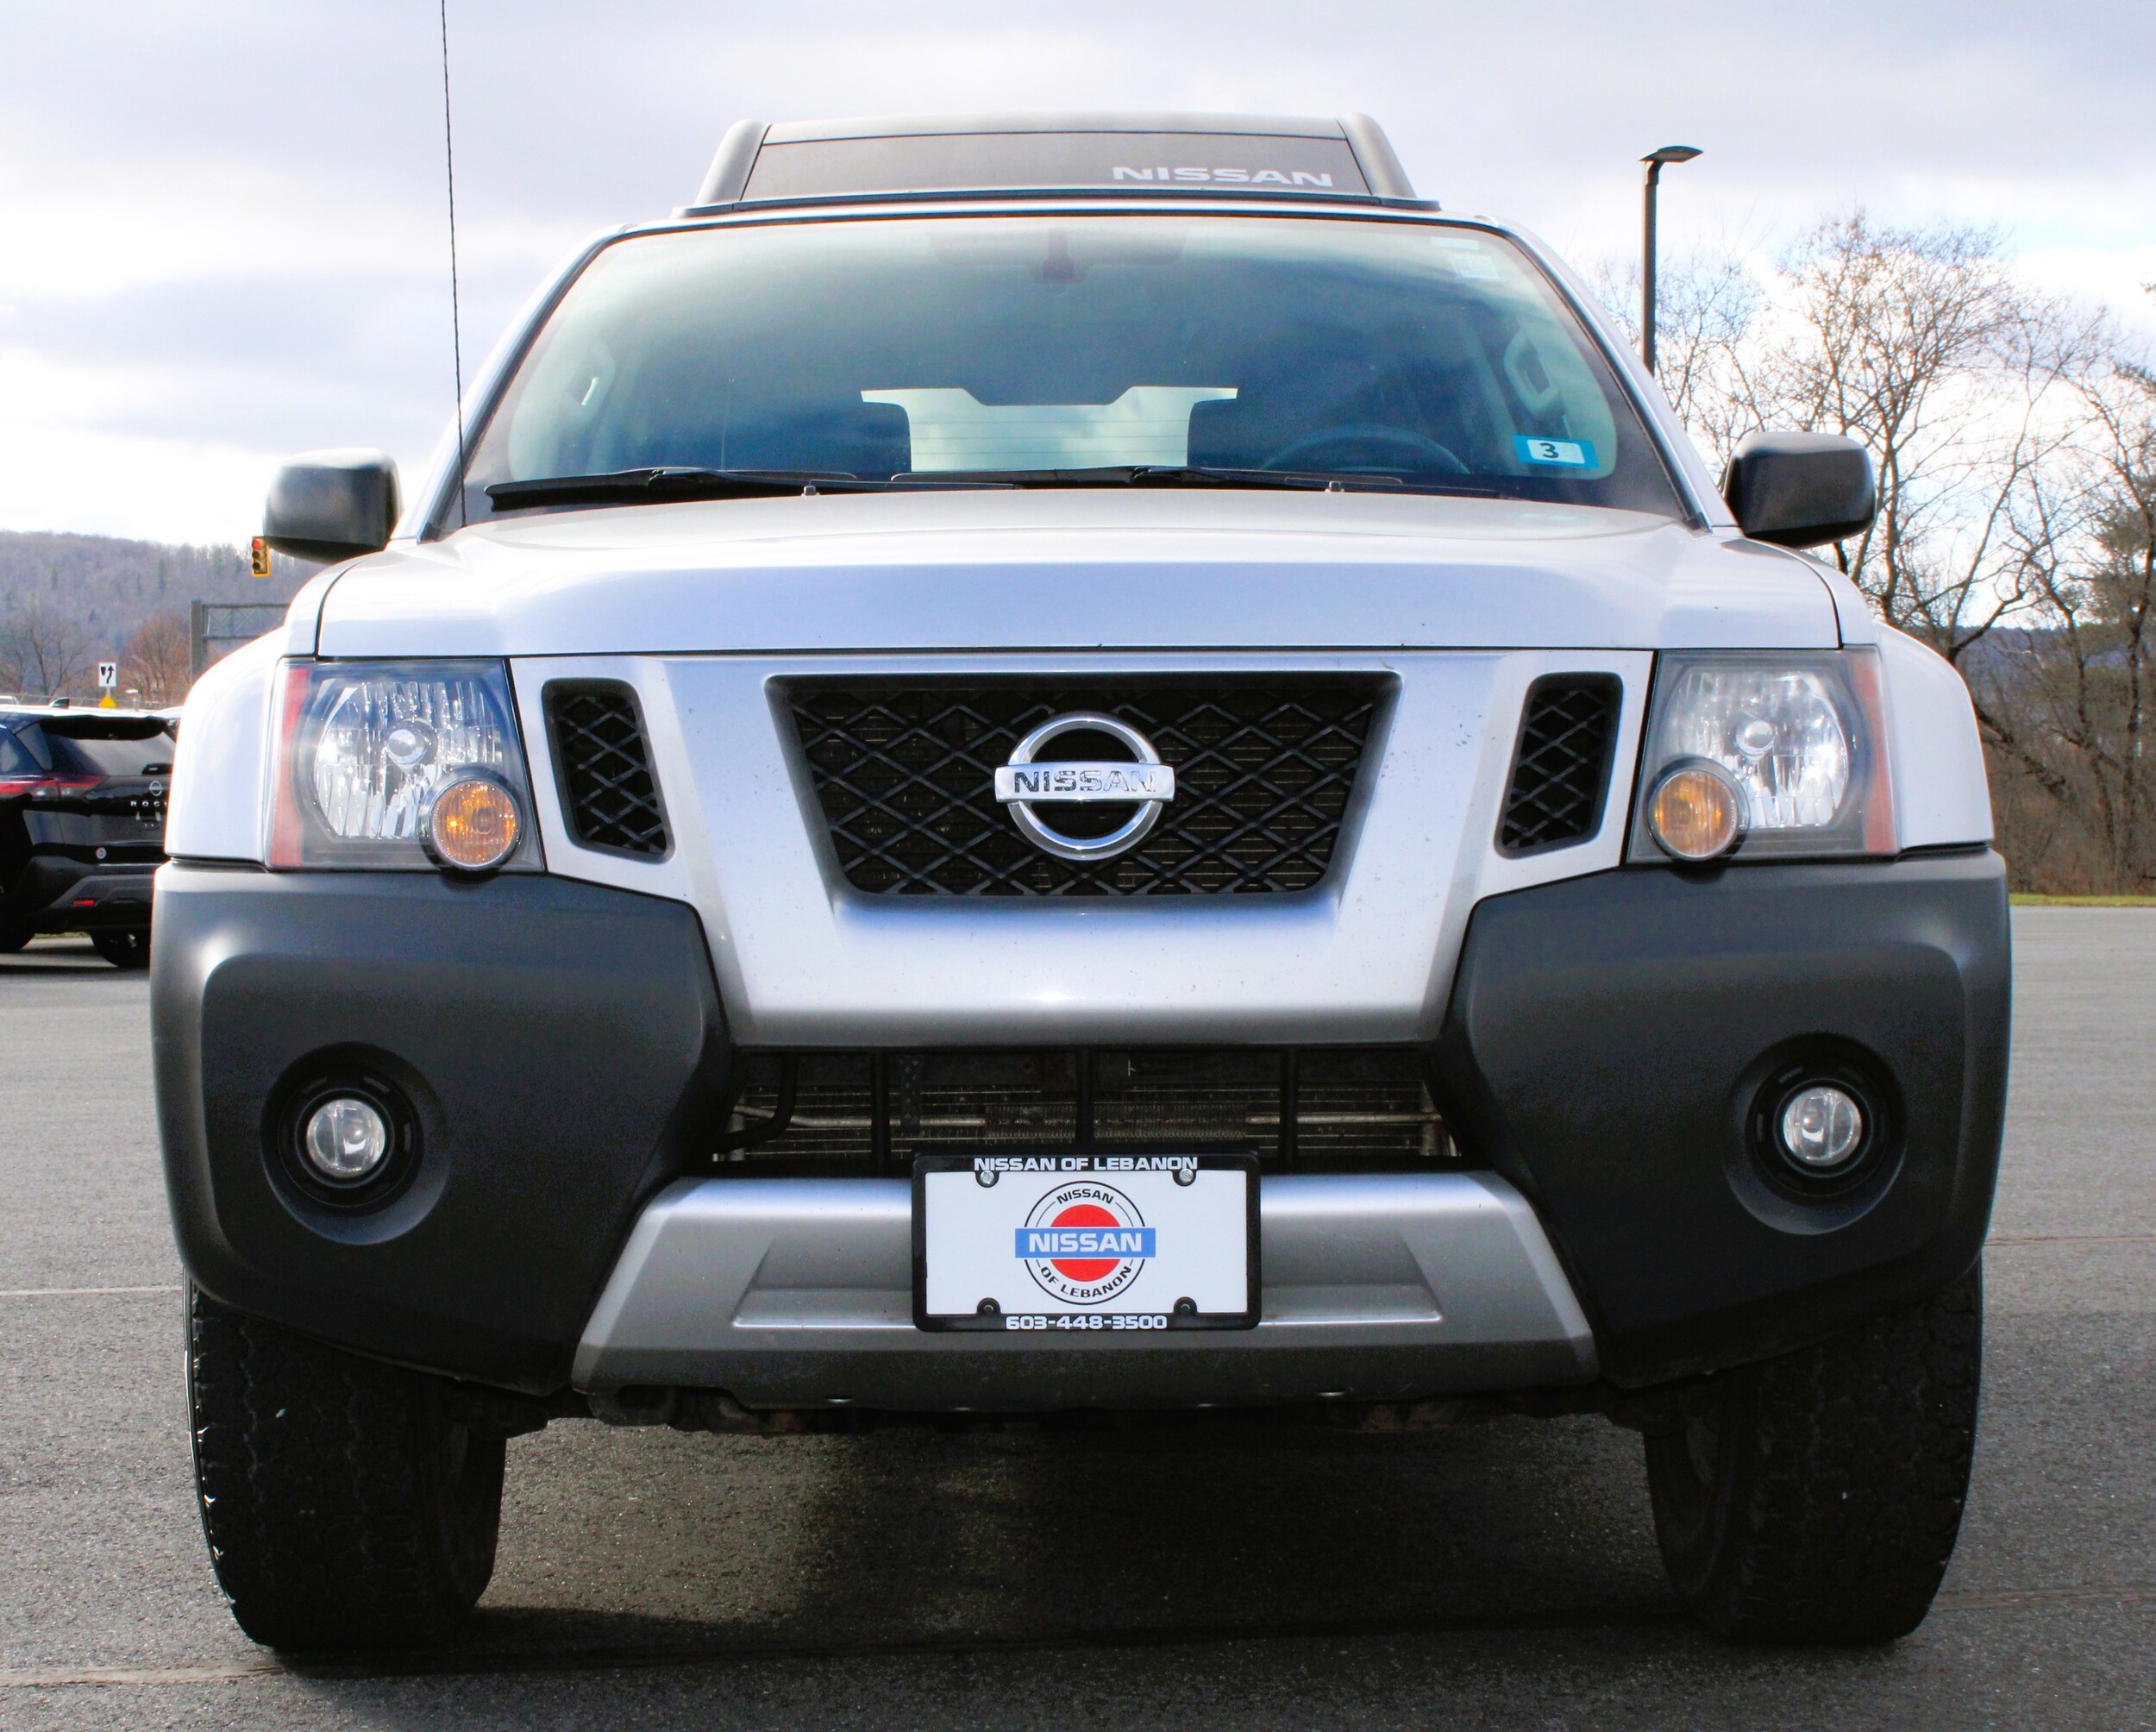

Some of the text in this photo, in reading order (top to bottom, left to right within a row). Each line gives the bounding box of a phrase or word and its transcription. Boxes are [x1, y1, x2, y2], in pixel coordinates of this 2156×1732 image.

[1112, 166, 1332, 187] NISSAN
[1539, 442, 1559, 459] 3
[1014, 770, 1156, 793] NISSAN
[974, 1157, 1198, 1171] NISSAN OF LEBANON
[1056, 1189, 1114, 1205] NISSAN
[1029, 1233, 1142, 1252] NISSAN
[1040, 1265, 1131, 1298] OF LEBANON
[1006, 1315, 1168, 1330] 603-448-3500
